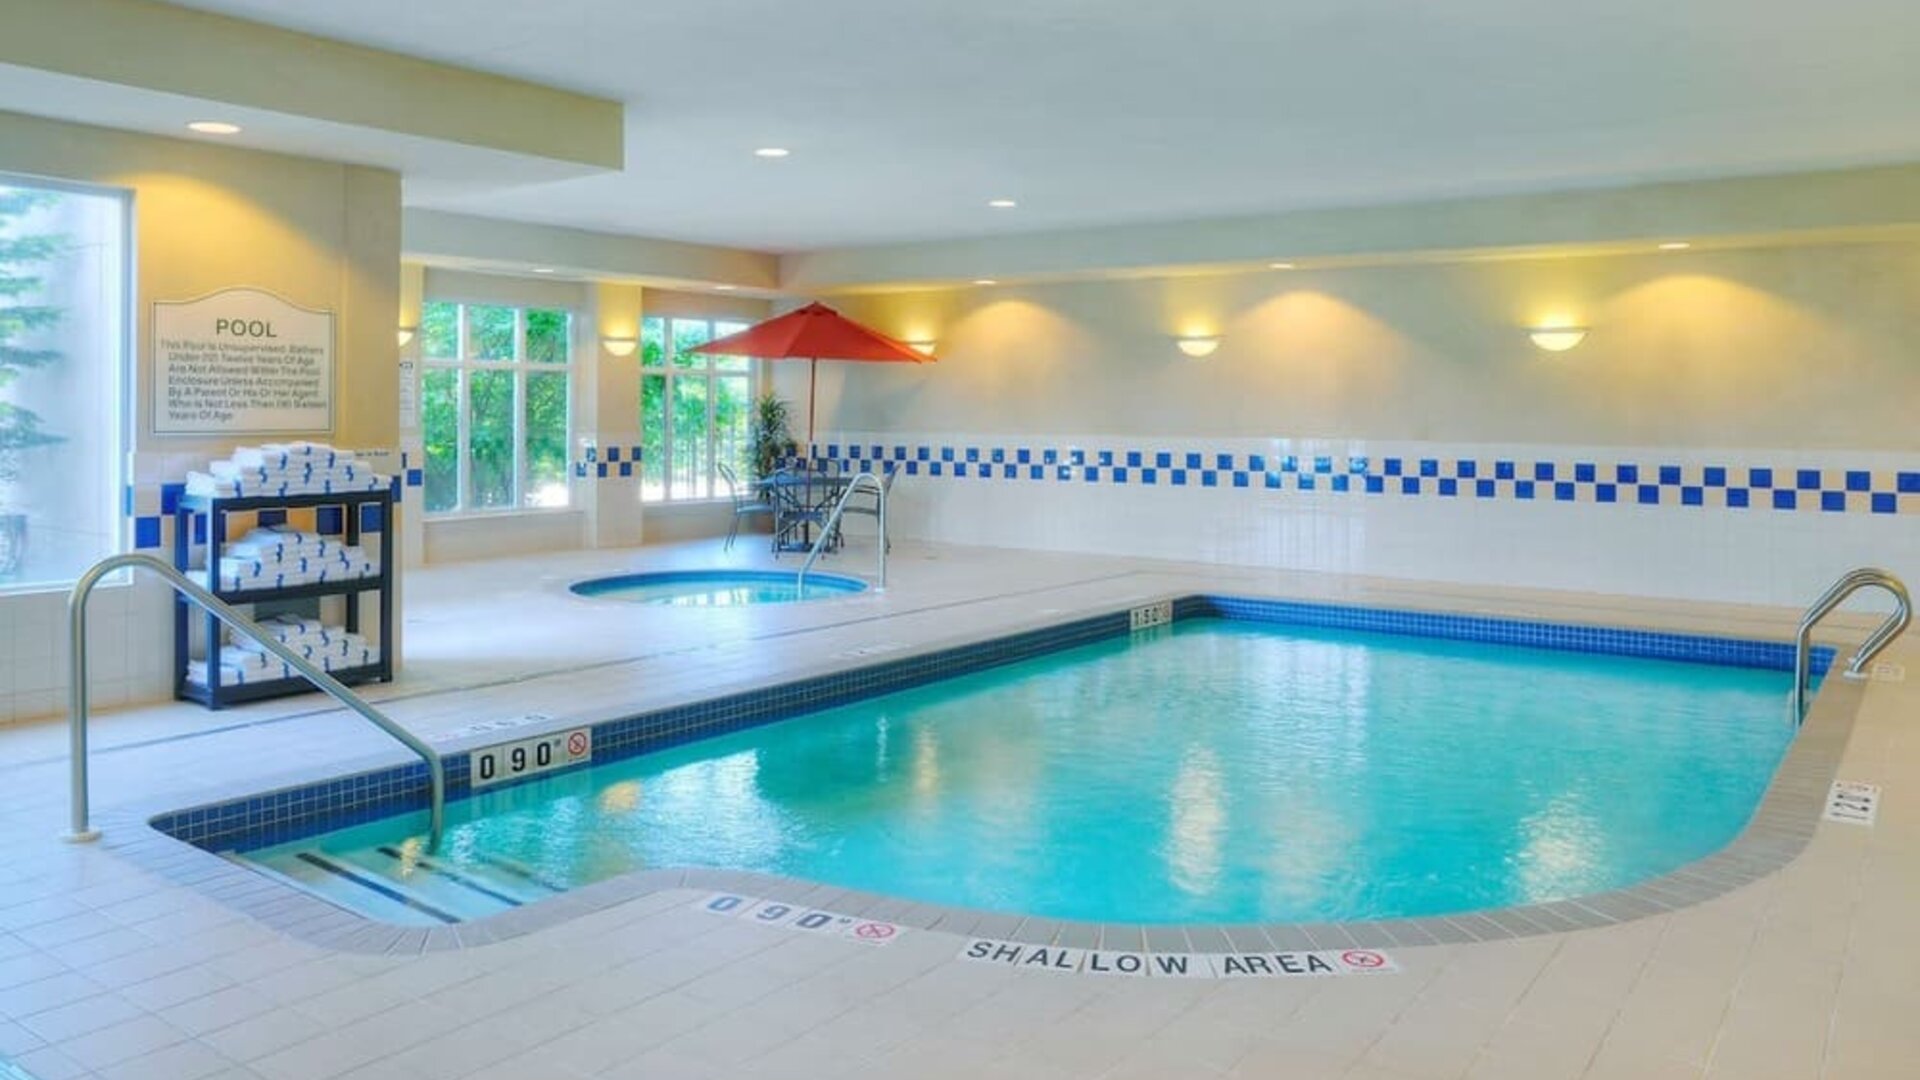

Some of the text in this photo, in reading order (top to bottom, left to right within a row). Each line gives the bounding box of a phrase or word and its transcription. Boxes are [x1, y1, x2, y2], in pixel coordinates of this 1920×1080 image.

[215, 318, 278, 338] POOL
[168, 351, 200, 362] Under
[297, 356, 315, 367] Age
[168, 363, 187, 373] Are
[188, 364, 206, 374] Not
[208, 364, 249, 375] Allowed
[168, 375, 218, 386] Enclosure
[220, 377, 253, 387] Unless
[168, 386, 182, 398] By
[184, 387, 194, 396] A
[195, 387, 227, 397] Parent
[228, 388, 241, 397] Or
[259, 389, 272, 398] Or
[205, 400, 223, 409] Not
[168, 410, 233, 423] Years Of Age
[966, 940, 1334, 976] SHALLOW AREA
